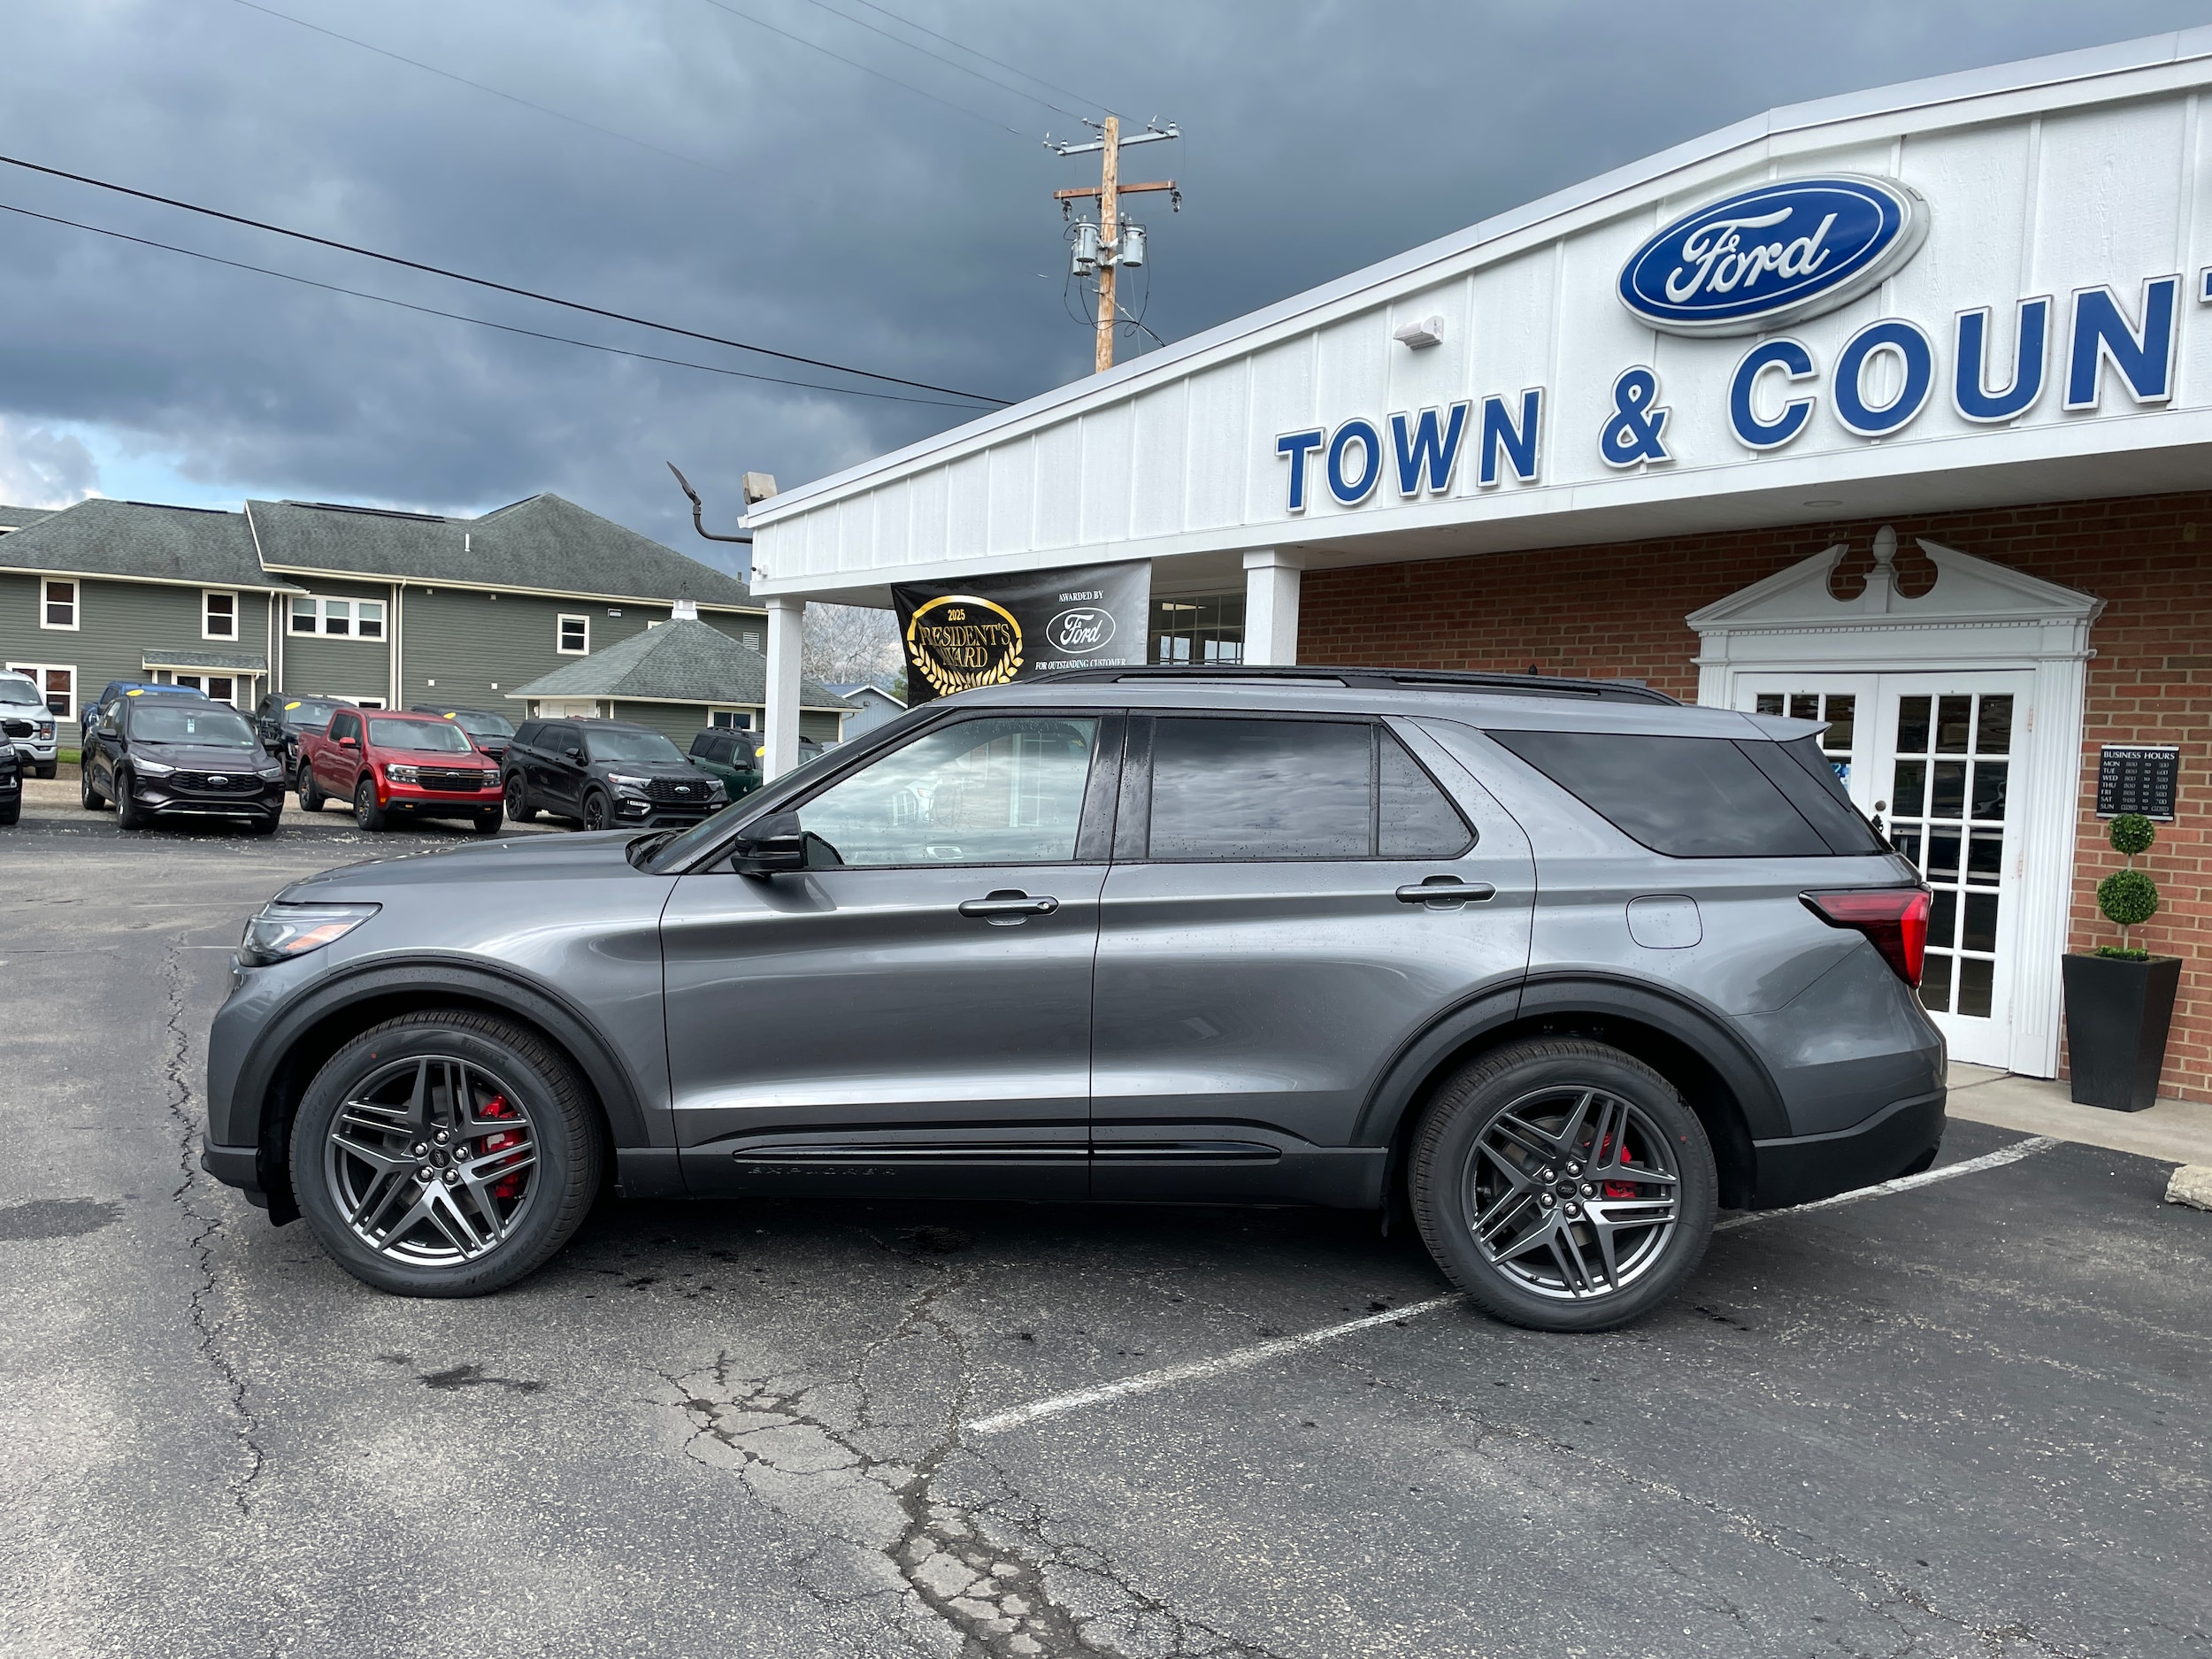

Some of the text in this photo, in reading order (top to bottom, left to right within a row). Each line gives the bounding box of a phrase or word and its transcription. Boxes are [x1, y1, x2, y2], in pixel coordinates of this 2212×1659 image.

[1664, 206, 1839, 304] Ford
[1276, 388, 1545, 515] TOWN
[1598, 365, 1672, 469] &
[1058, 590, 1103, 603] AWARDED BY
[947, 609, 966, 622] 2025
[920, 622, 1011, 647] PRESIDENT'S
[1059, 613, 1102, 646] Ford
[1035, 661, 1048, 671] FOR
[1048, 659, 1089, 671] OUTSTANDING
